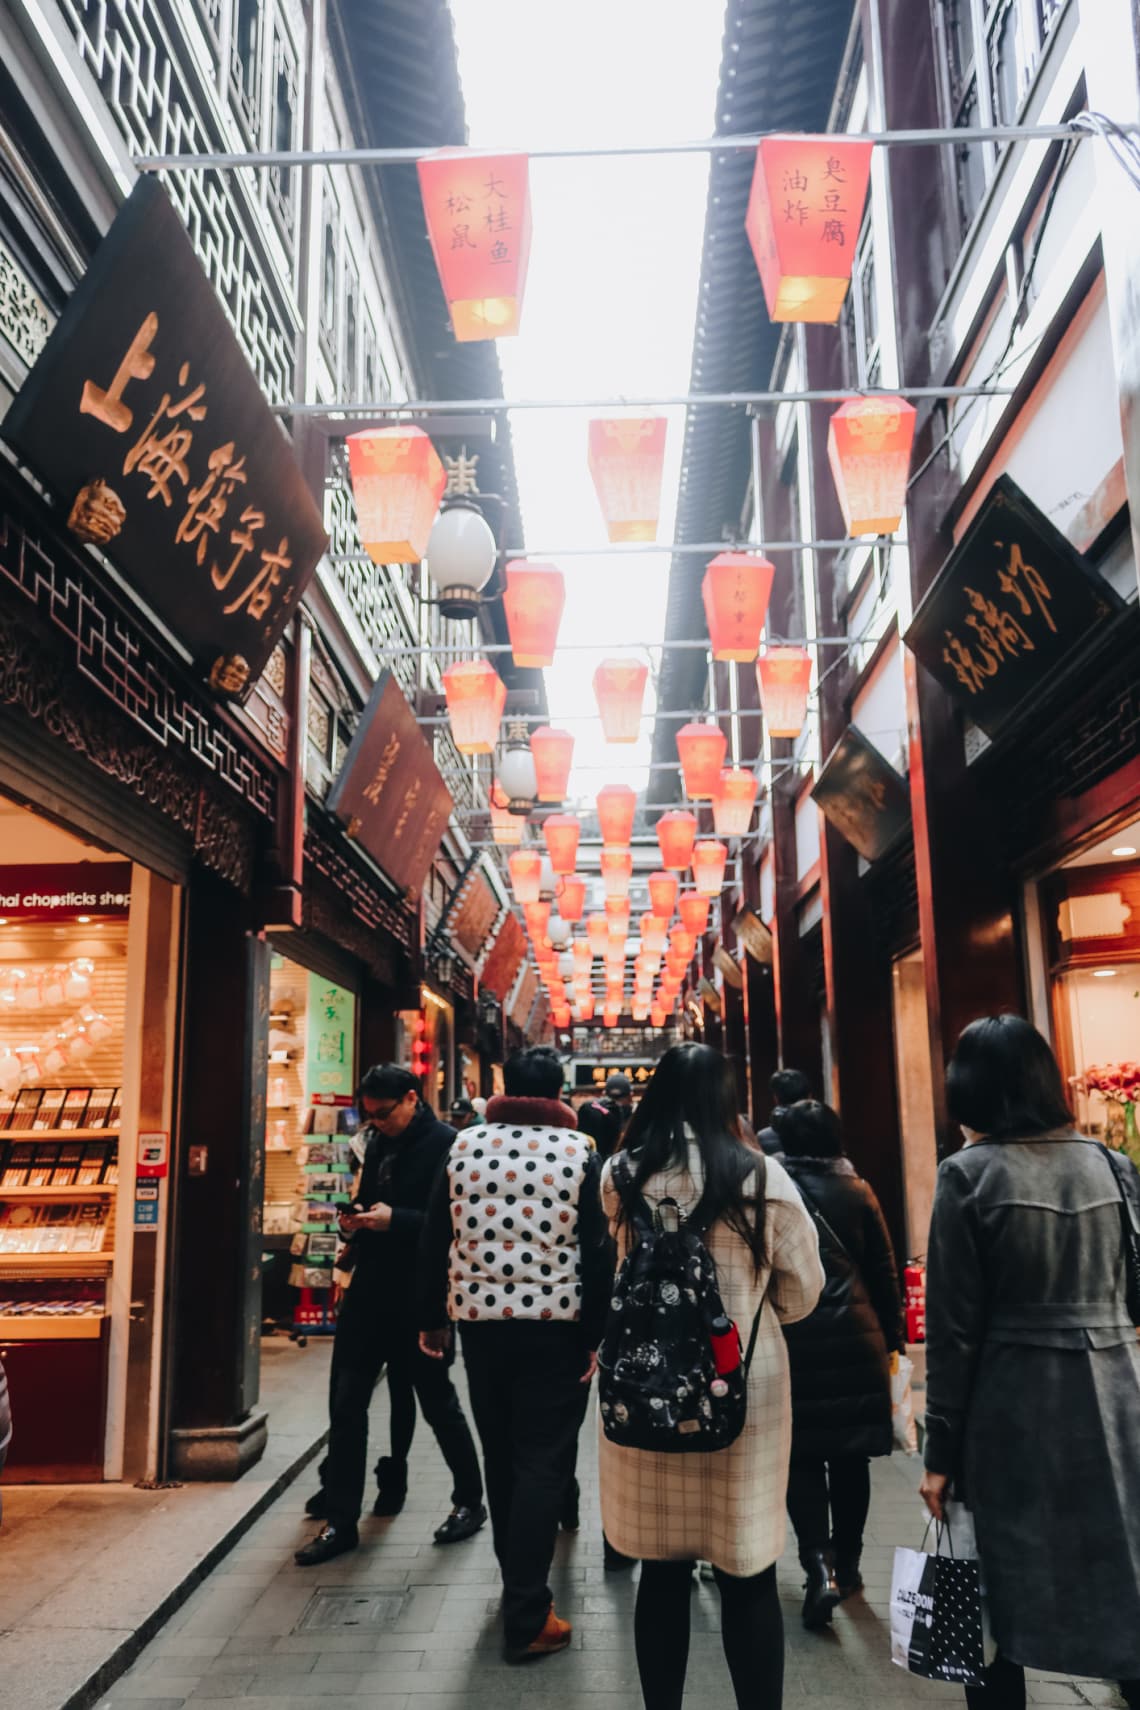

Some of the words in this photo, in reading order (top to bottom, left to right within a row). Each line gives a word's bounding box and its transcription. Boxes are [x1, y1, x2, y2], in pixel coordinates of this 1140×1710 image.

[445, 190, 478, 250] 松鼠
[482, 171, 513, 265] 大桂鱼
[783, 169, 809, 226] 油炸
[818, 156, 848, 246] 臭豆腐
[80, 311, 292, 621] 上海筷子店
[23, 892, 97, 909] chopsticks
